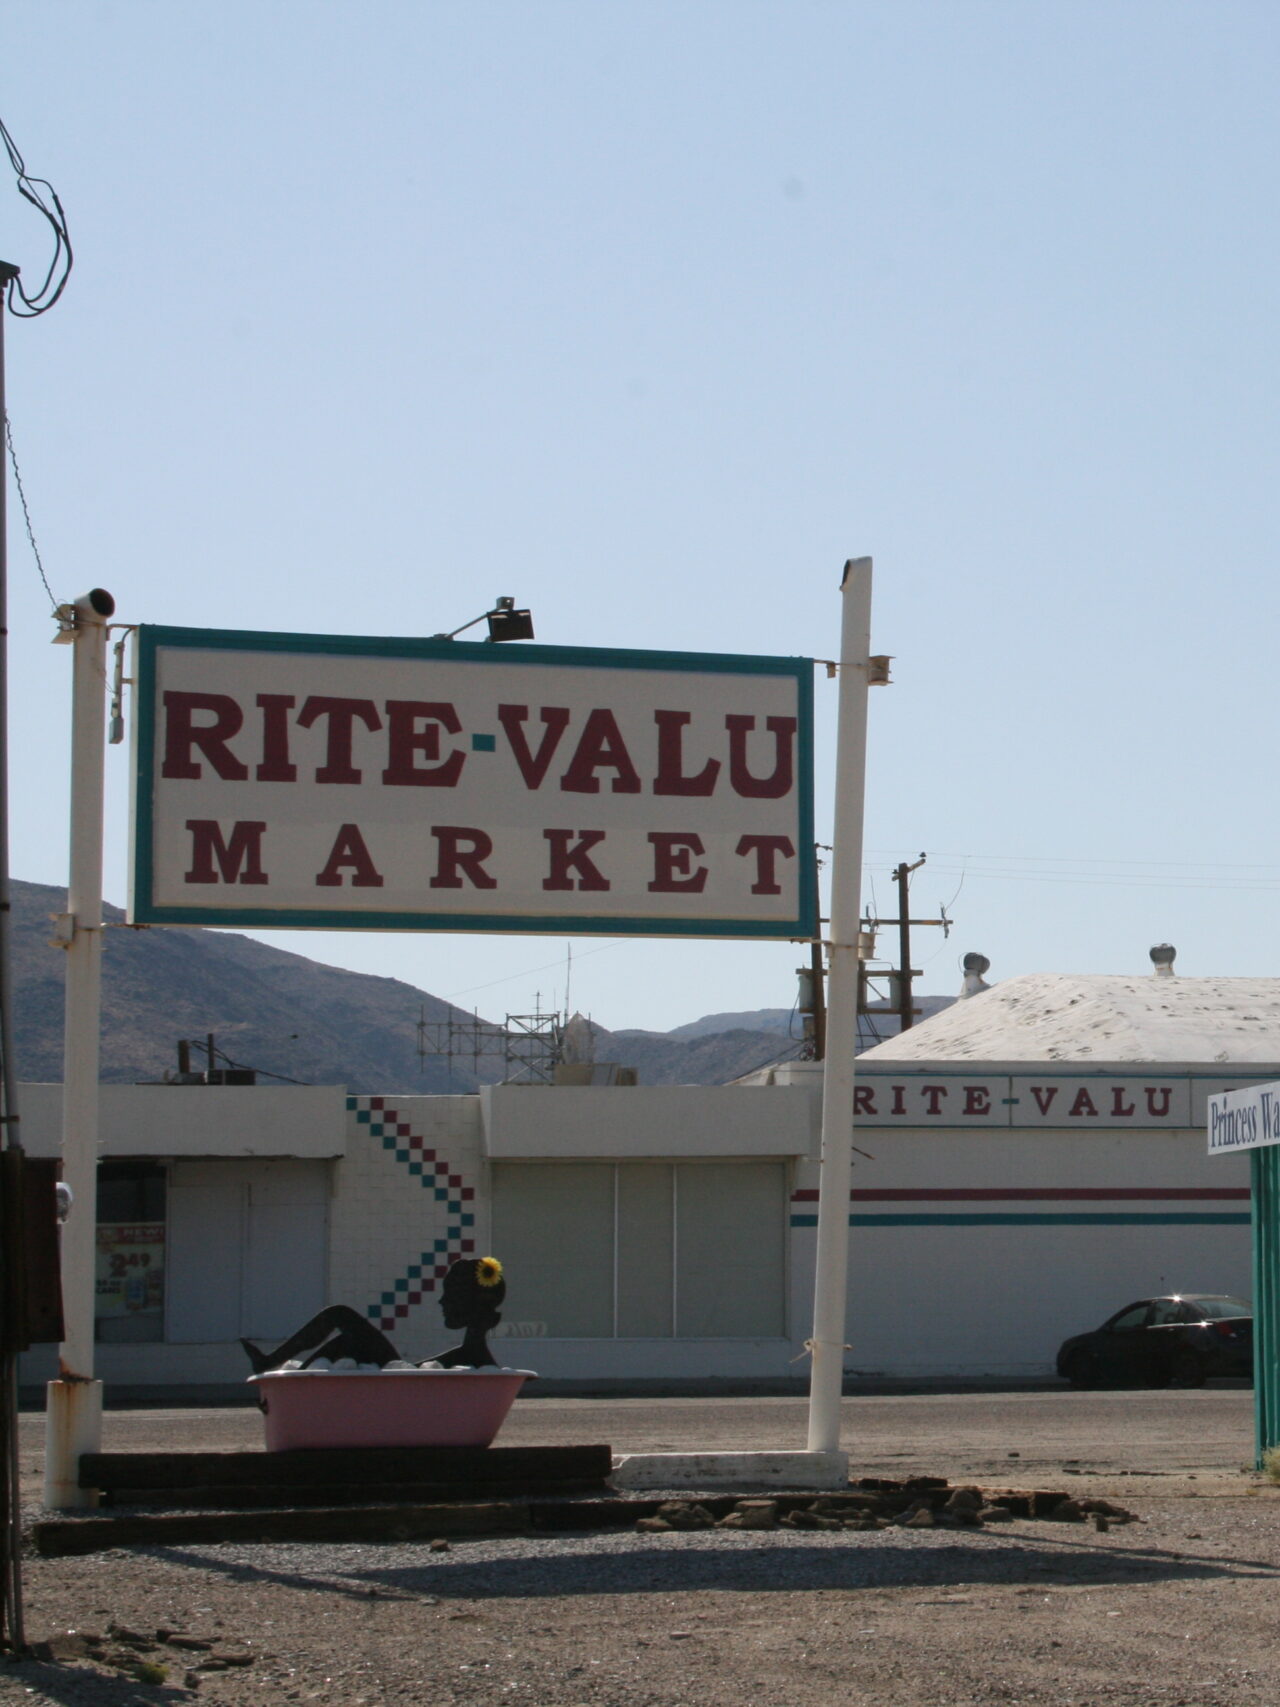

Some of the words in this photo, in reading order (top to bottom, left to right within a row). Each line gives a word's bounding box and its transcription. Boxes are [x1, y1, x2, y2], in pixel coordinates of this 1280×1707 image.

[162, 690, 797, 799] RITE-VALU
[184, 819, 796, 895] MARKET
[853, 1085, 1173, 1117] RITE-VALU
[1210, 1096, 1257, 1147] Princess
